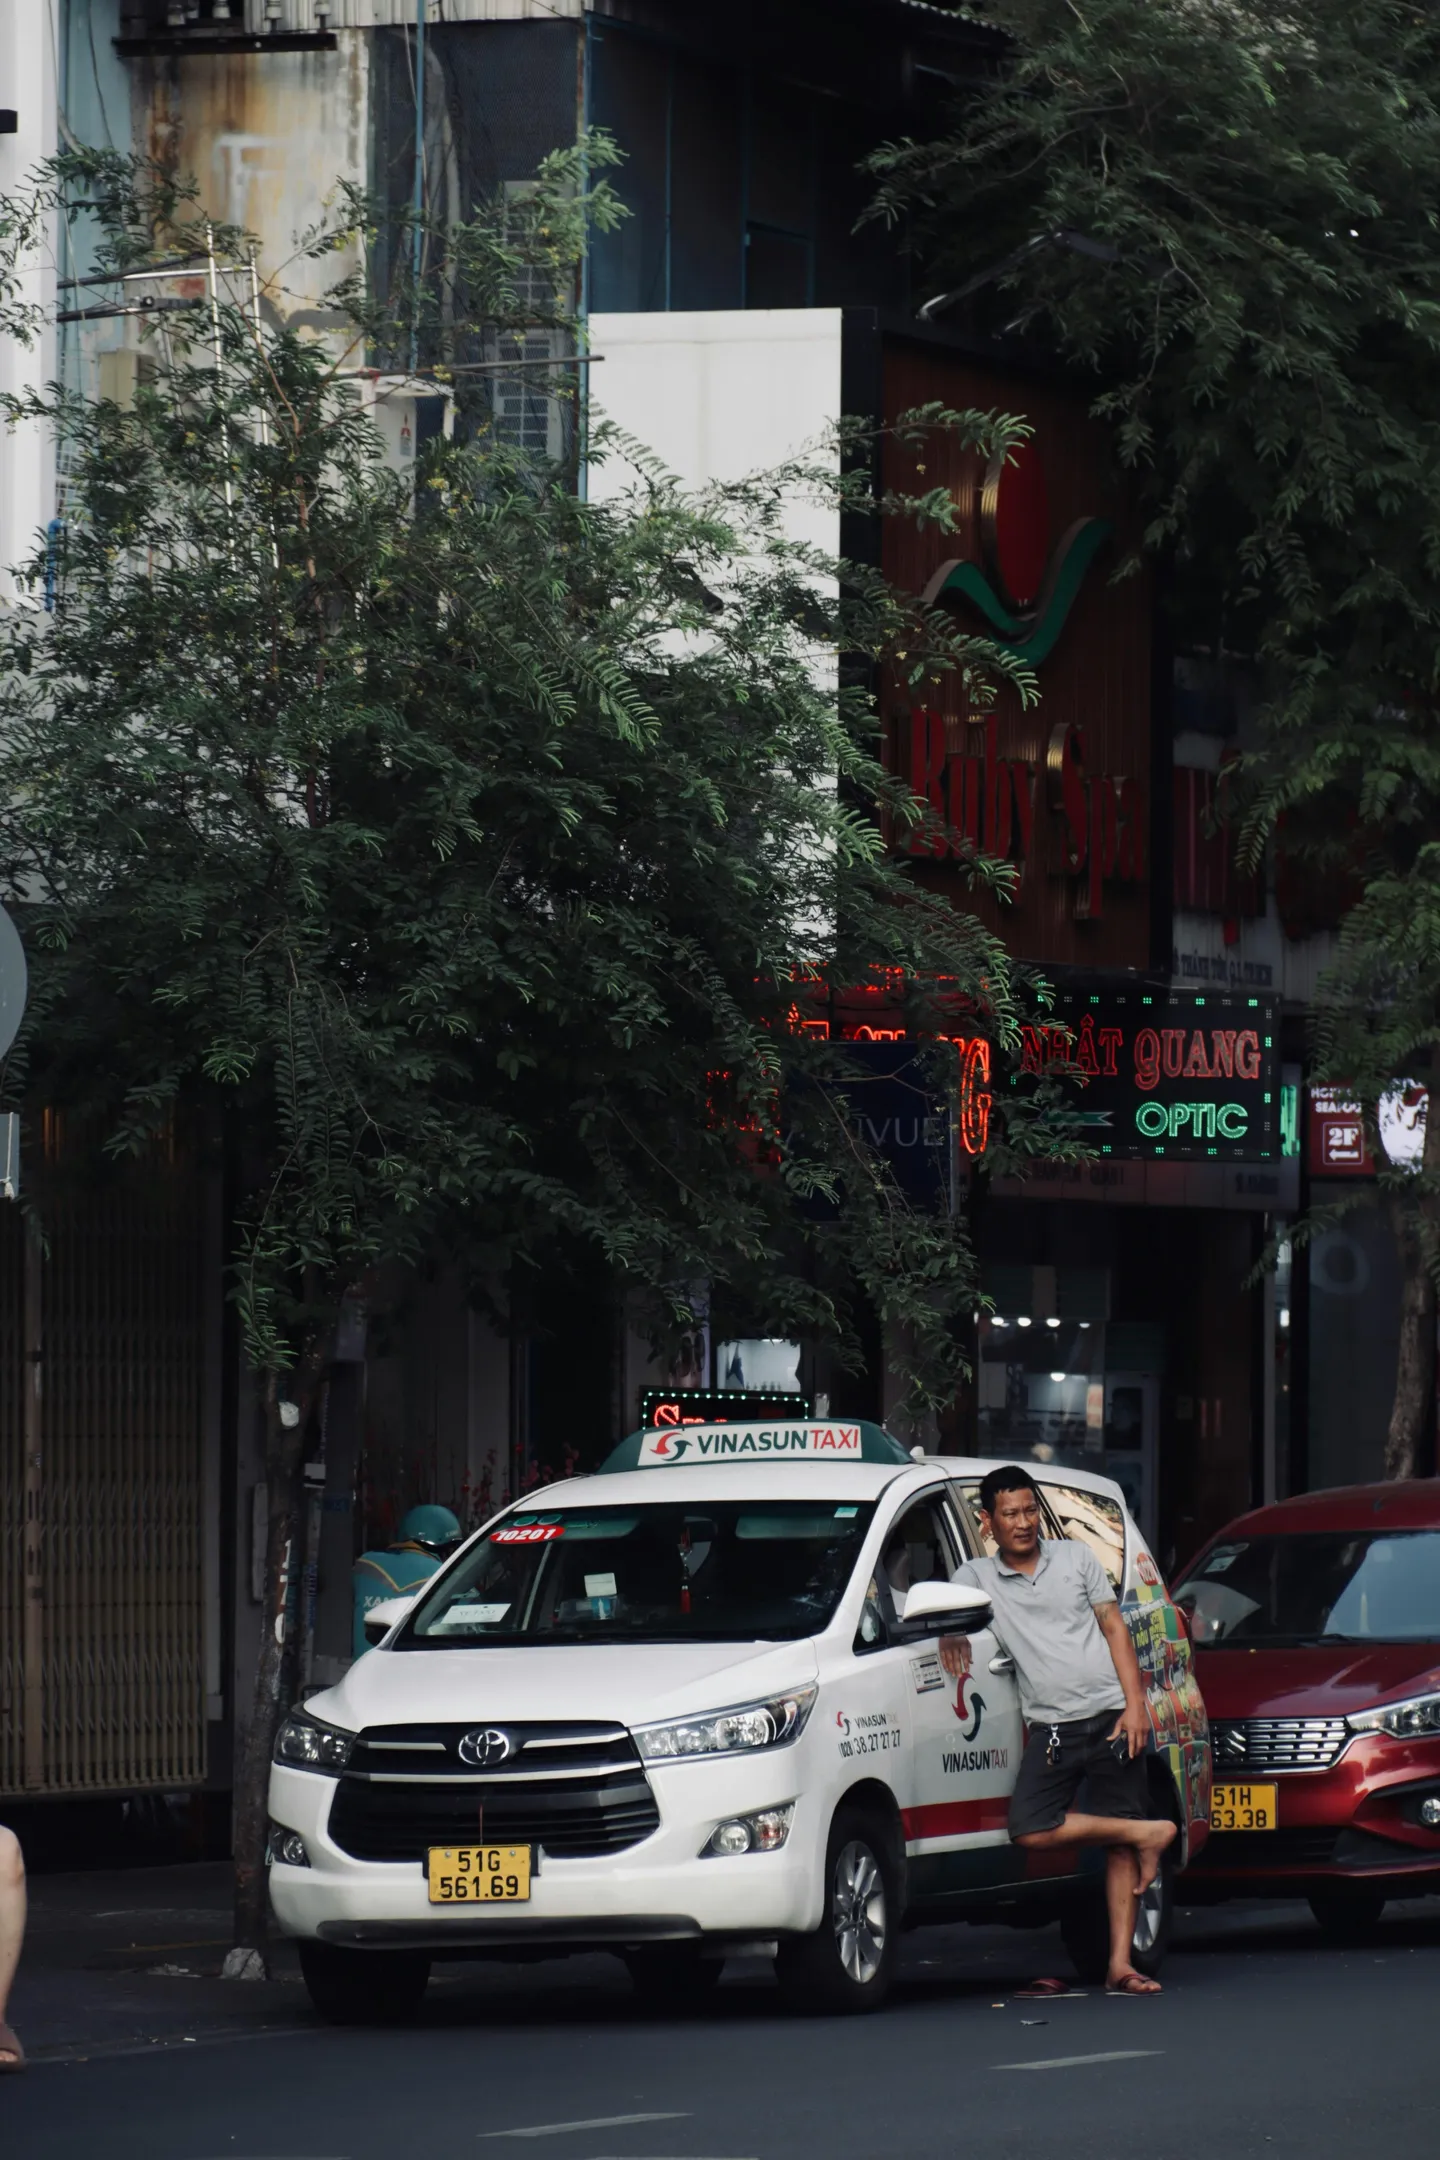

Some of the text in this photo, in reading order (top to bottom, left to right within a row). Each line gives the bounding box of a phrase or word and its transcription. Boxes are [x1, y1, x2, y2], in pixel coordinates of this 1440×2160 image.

[911, 708, 1144, 918] Ruby Spa
[1133, 1027, 1261, 1091] QUANG
[1135, 1101, 1249, 1139] OPTIC
[1328, 1127, 1359, 1146] 2F
[496, 1528, 556, 1542] 10201
[880, 1731, 890, 1750] 27
[891, 1729, 901, 1748] 27
[1213, 1787, 1251, 1806] 51H
[1210, 1809, 1267, 1829] 63.38
[458, 1850, 501, 1872] 51G
[440, 1875, 518, 1899] 561.69
